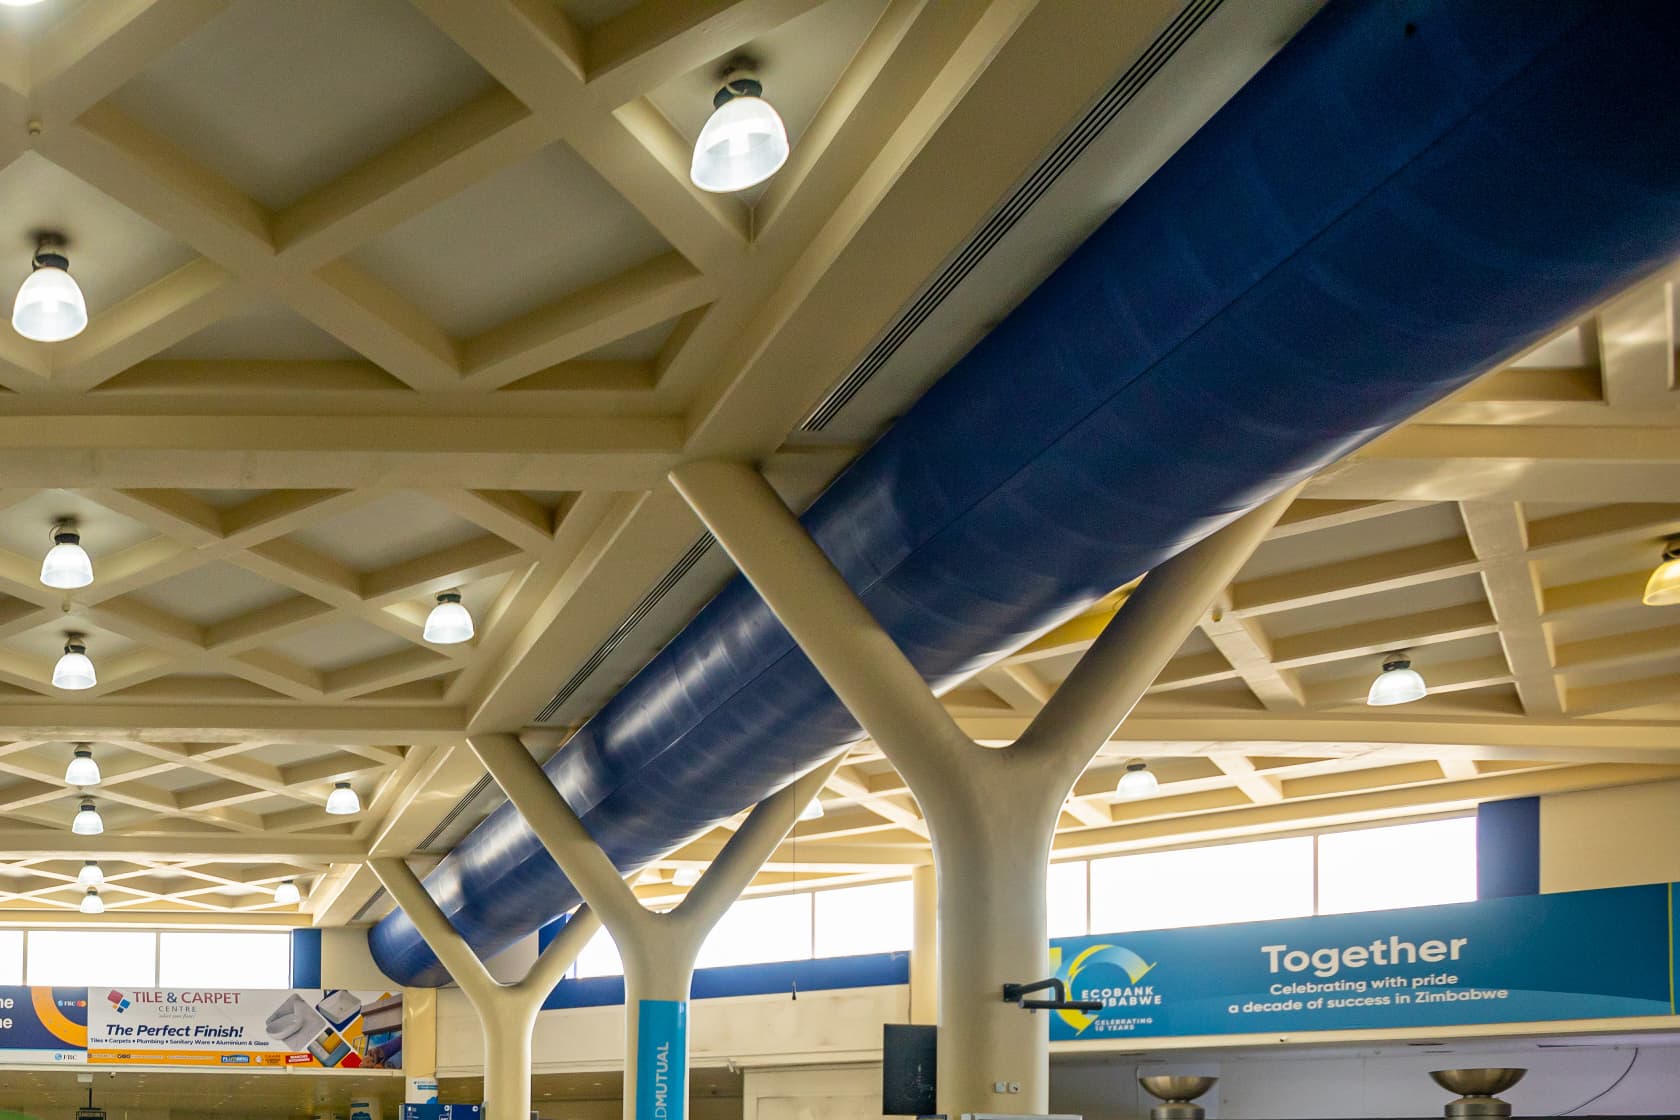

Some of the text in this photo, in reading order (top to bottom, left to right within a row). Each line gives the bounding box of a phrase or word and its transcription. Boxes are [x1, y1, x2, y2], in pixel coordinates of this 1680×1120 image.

[1261, 936, 1468, 978] Together
[1270, 973, 1459, 996] Celebrating with pride
[132, 991, 241, 1004] TILE & CARPET
[1081, 986, 1154, 999] ECOBANK
[1082, 995, 1162, 1007] MBABWE
[1228, 988, 1509, 1014] a decade of success in Zimbabwe
[1094, 1017, 1153, 1027] CELEBRATING
[106, 1024, 244, 1038] The Perfect Finish!
